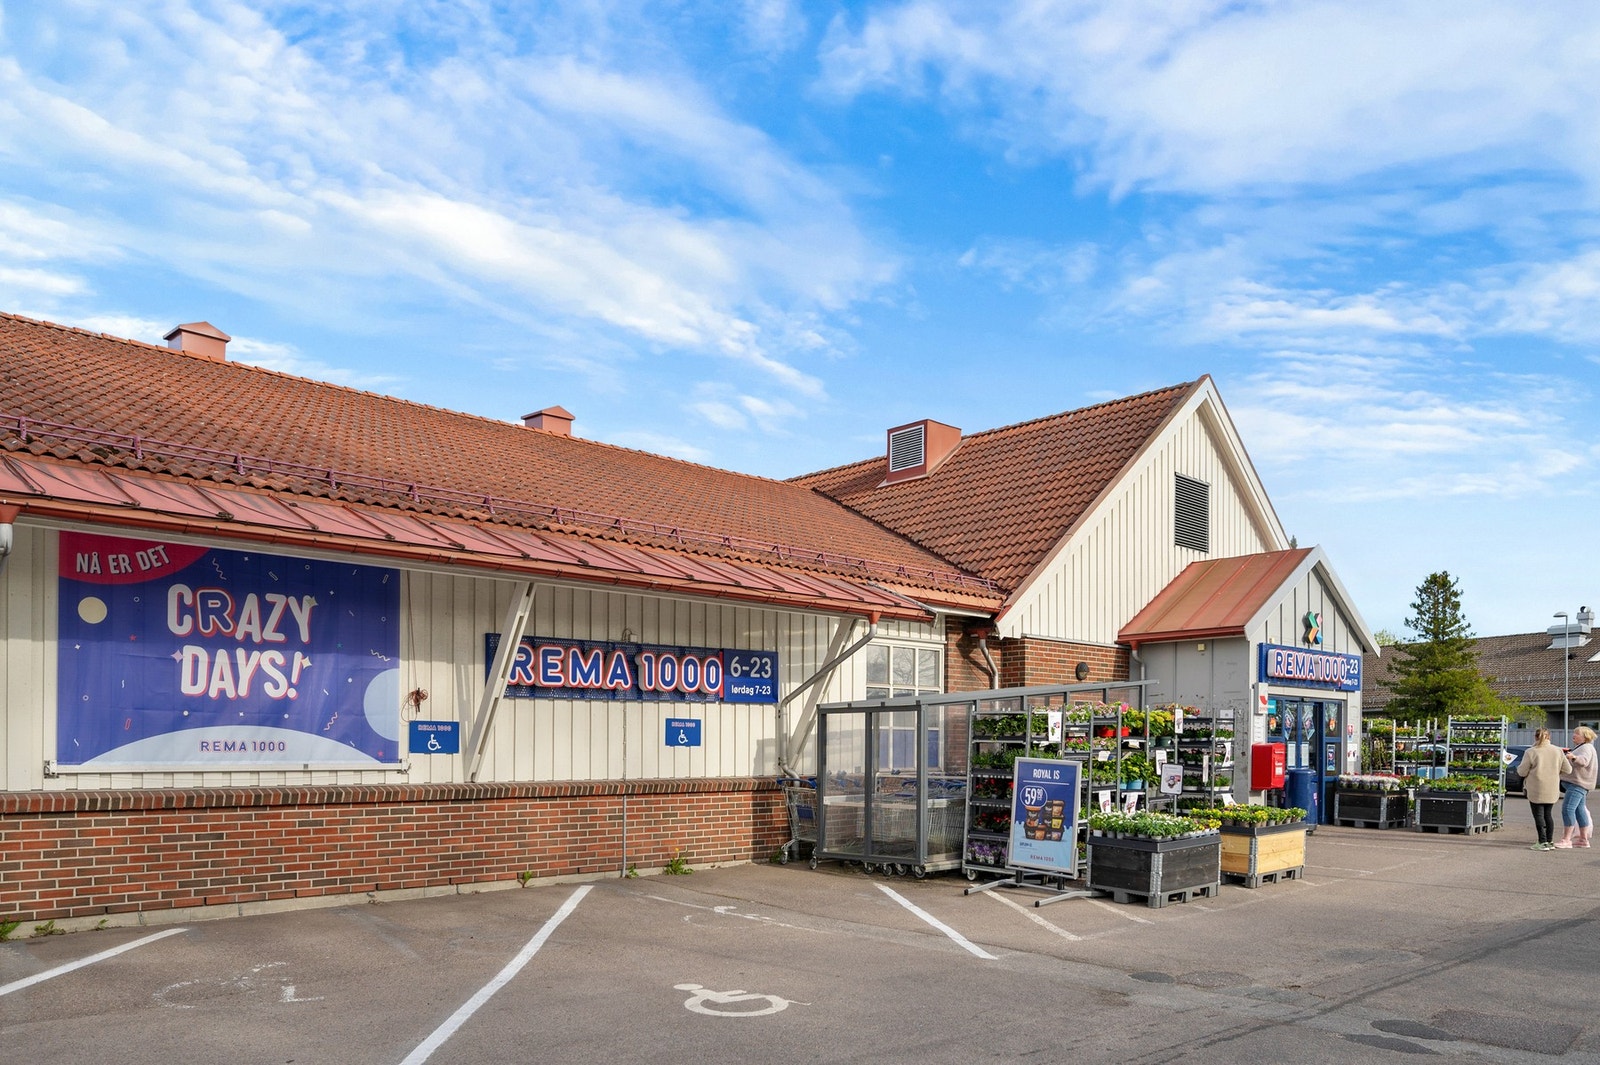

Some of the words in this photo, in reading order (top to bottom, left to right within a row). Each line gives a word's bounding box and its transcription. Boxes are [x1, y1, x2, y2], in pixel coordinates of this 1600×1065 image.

[76, 551, 102, 574] NÅ
[108, 553, 133, 575] ER
[135, 545, 171, 571] DET
[167, 583, 313, 643] CRAZY
[180, 644, 303, 699] DAYS!
[508, 642, 633, 690] REMA
[641, 650, 723, 694] 1000
[730, 656, 772, 678] 6-23
[1274, 649, 1316, 679] REMA
[1318, 655, 1347, 682] 1000
[731, 685, 754, 696] lørdag
[755, 685, 771, 695] 7-23
[200, 740, 247, 752] REMA
[252, 740, 286, 752] 1000
[1032, 768, 1052, 780] ROYAL
[1053, 769, 1060, 780] IS
